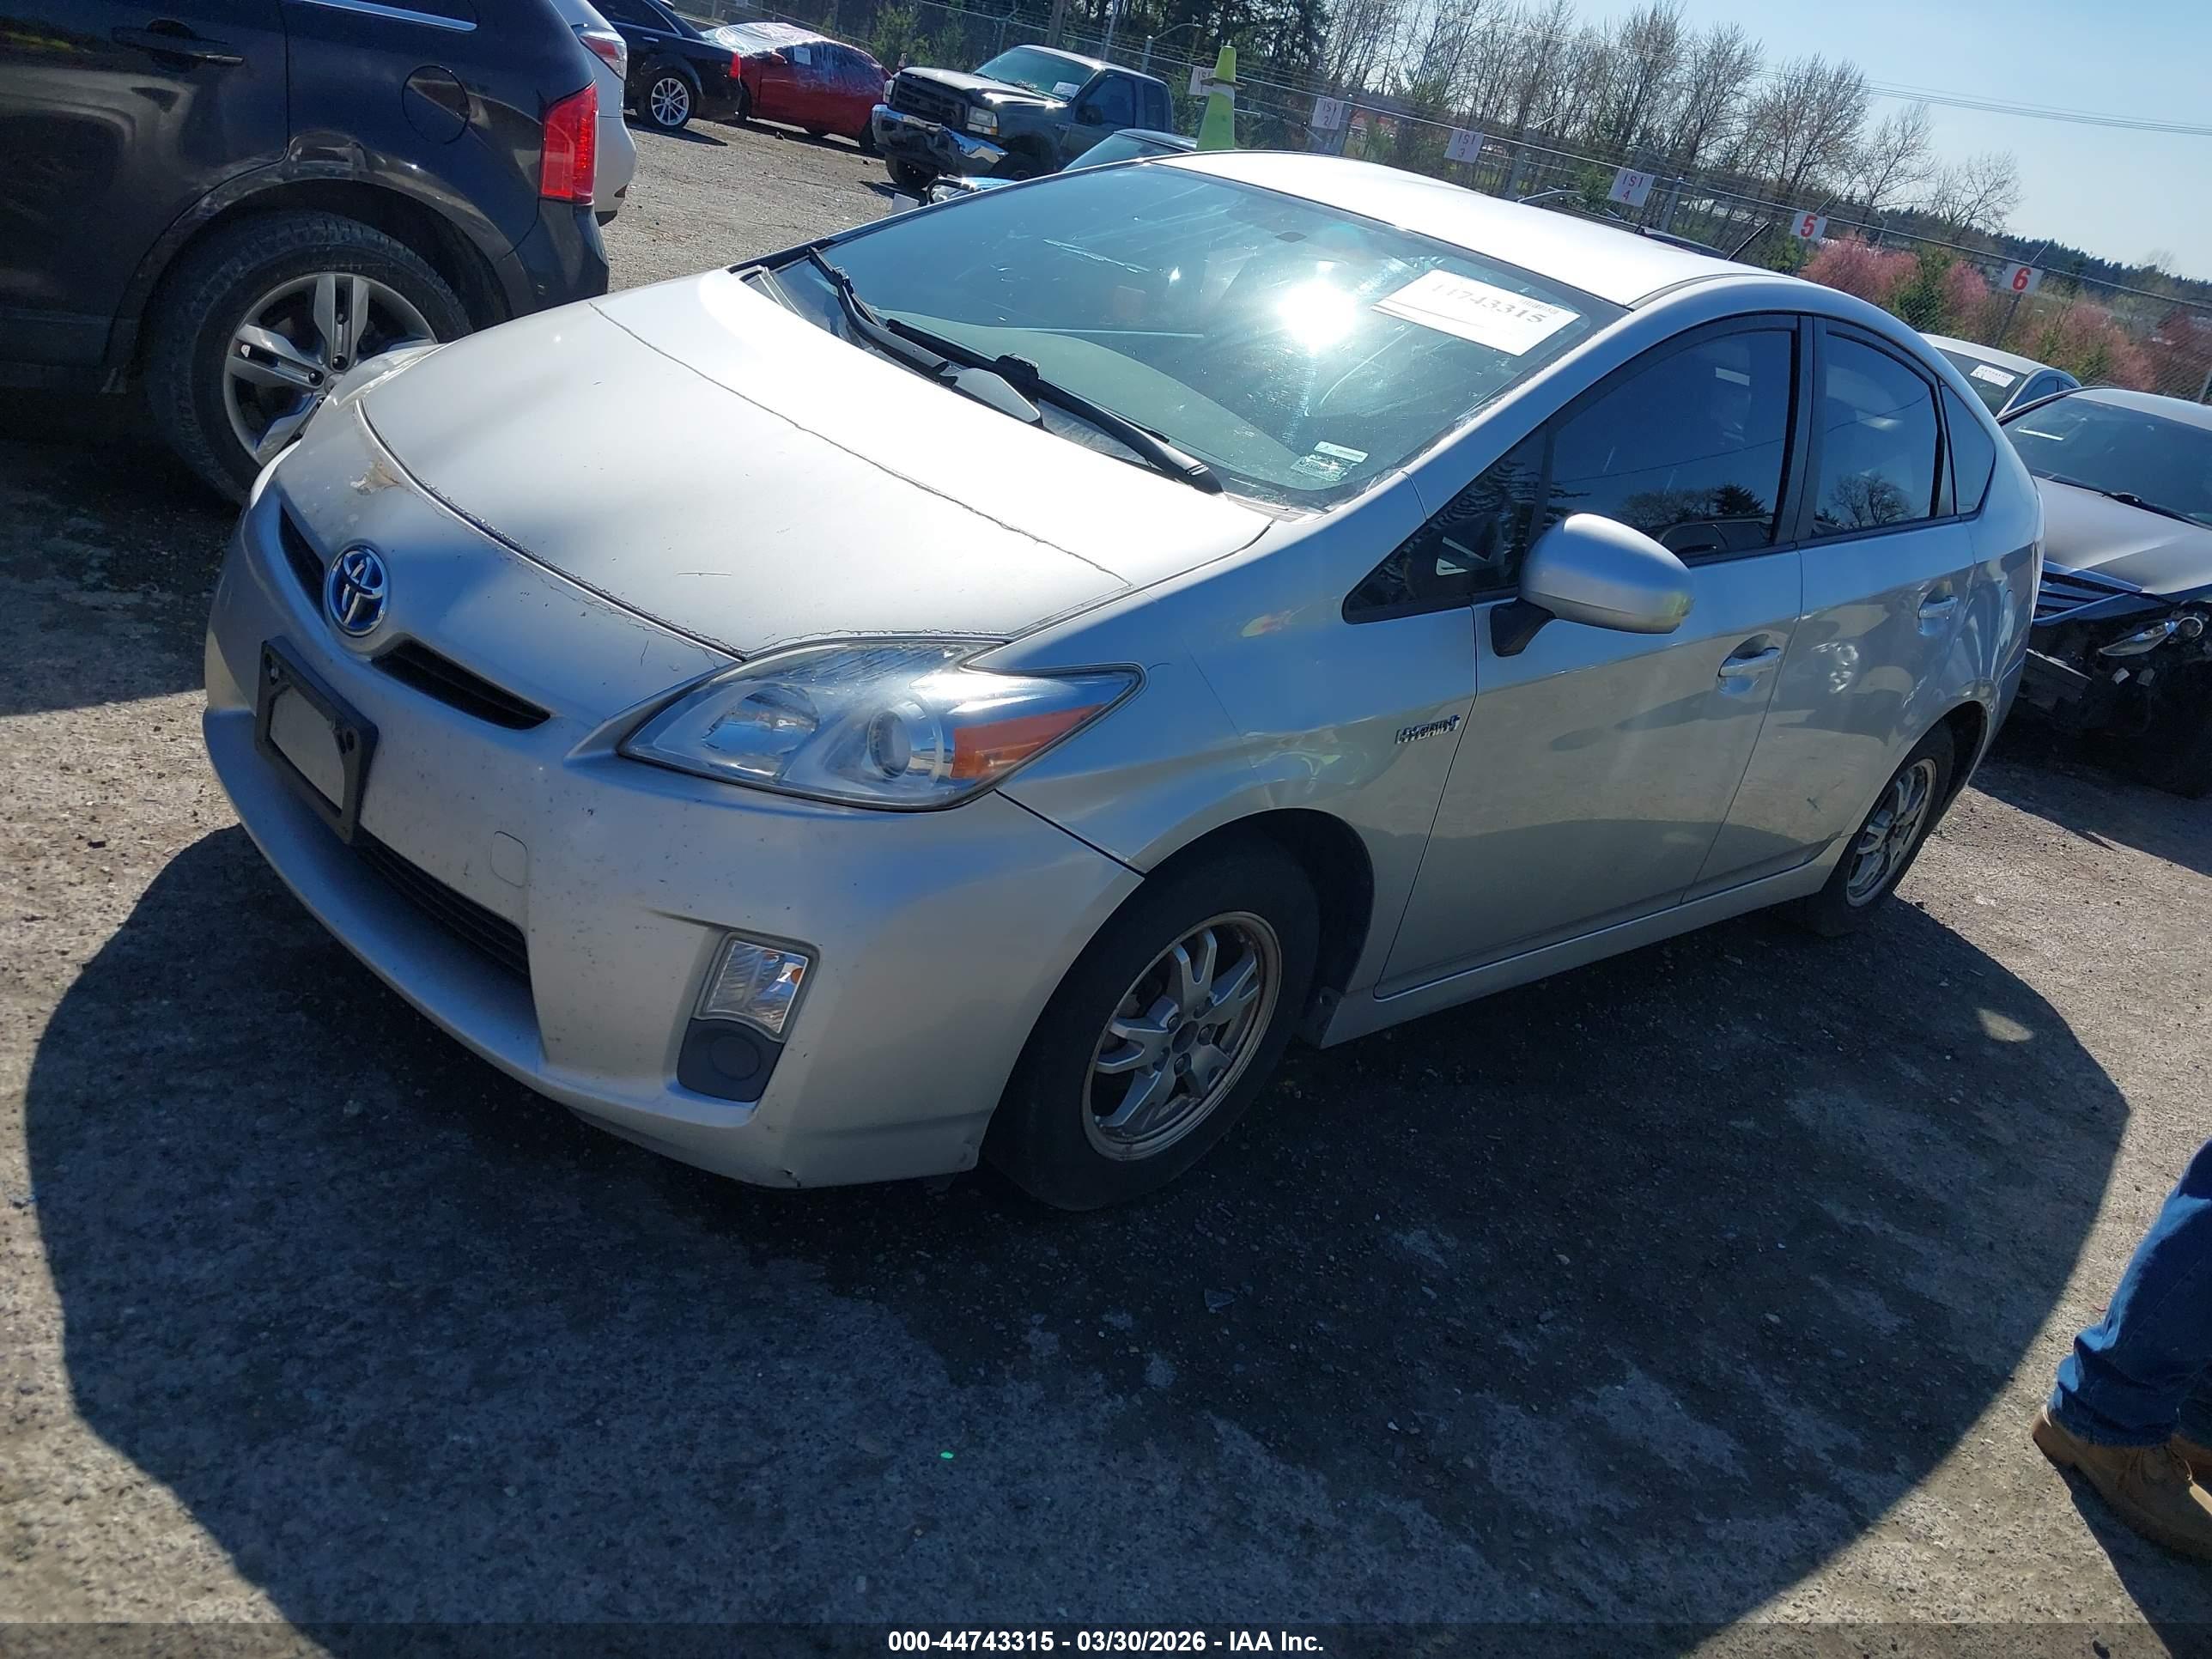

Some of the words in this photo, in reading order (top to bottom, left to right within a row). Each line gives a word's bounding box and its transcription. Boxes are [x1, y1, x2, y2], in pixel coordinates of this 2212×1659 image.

[1457, 148, 1466, 158] 3
[1623, 190, 1631, 200] 4
[1800, 215, 1818, 238] 5
[2012, 267, 2032, 290] 6
